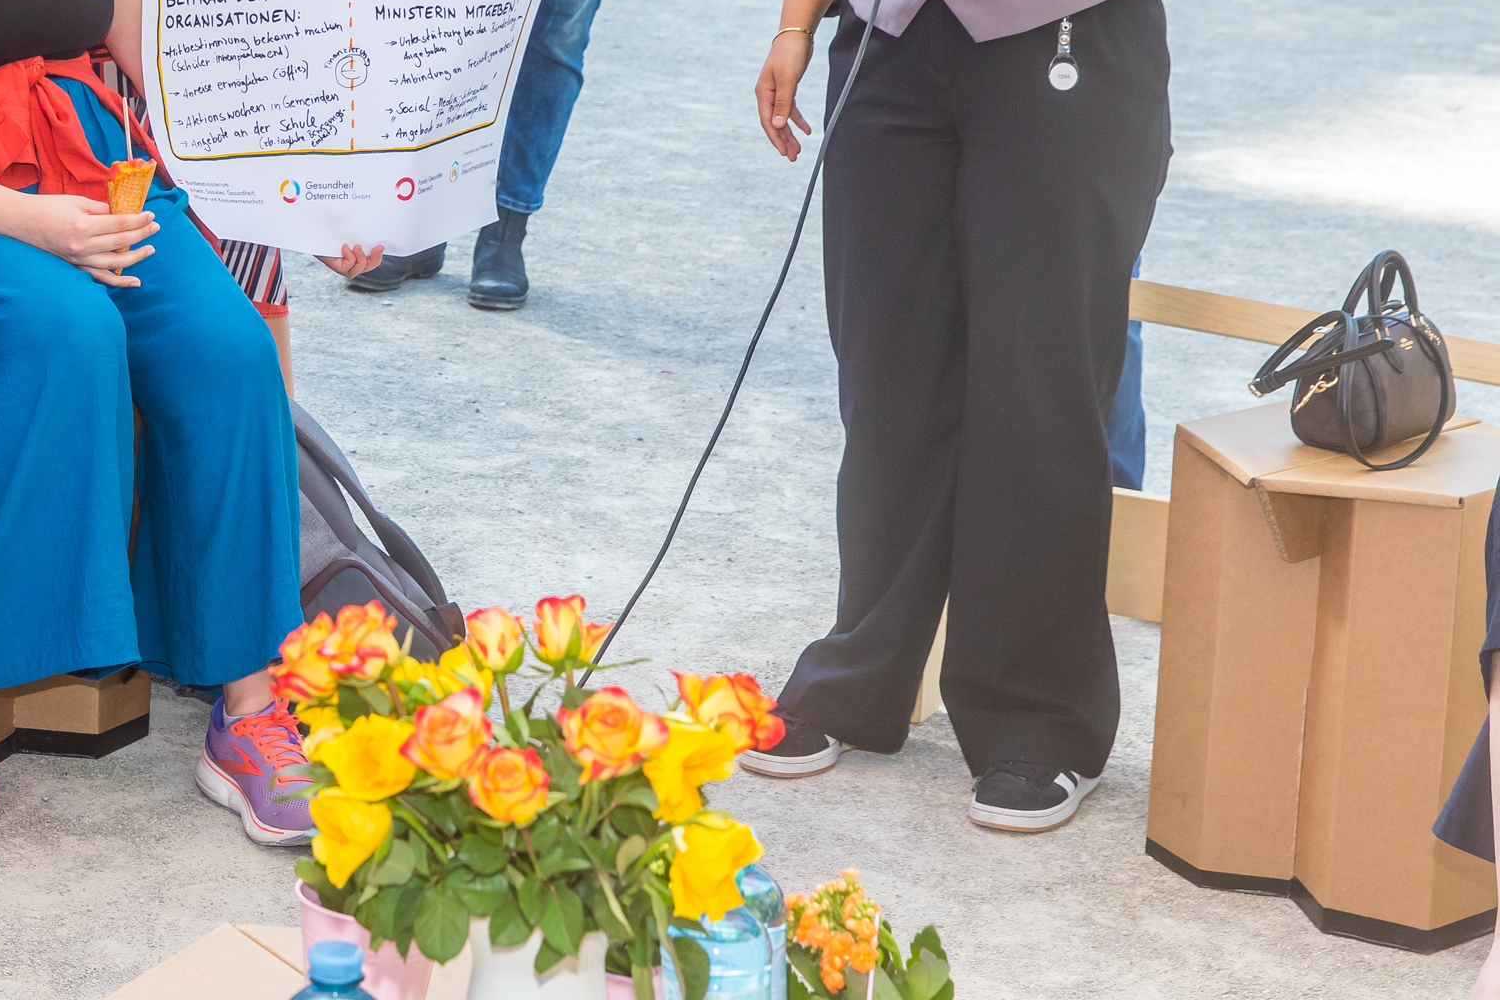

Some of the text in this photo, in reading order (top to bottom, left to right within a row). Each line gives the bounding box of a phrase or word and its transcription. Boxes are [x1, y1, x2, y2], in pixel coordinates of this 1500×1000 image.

[374, 4, 457, 21] MINISTERIN
[253, 25, 301, 47] bekannt
[400, 68, 452, 86] Anbindung
[281, 89, 340, 110] Gemeinden
[233, 127, 249, 138] an
[253, 120, 271, 135] der
[279, 108, 318, 132] Schule
[305, 180, 355, 190] Gesundheit
[305, 190, 349, 200] Österreich
